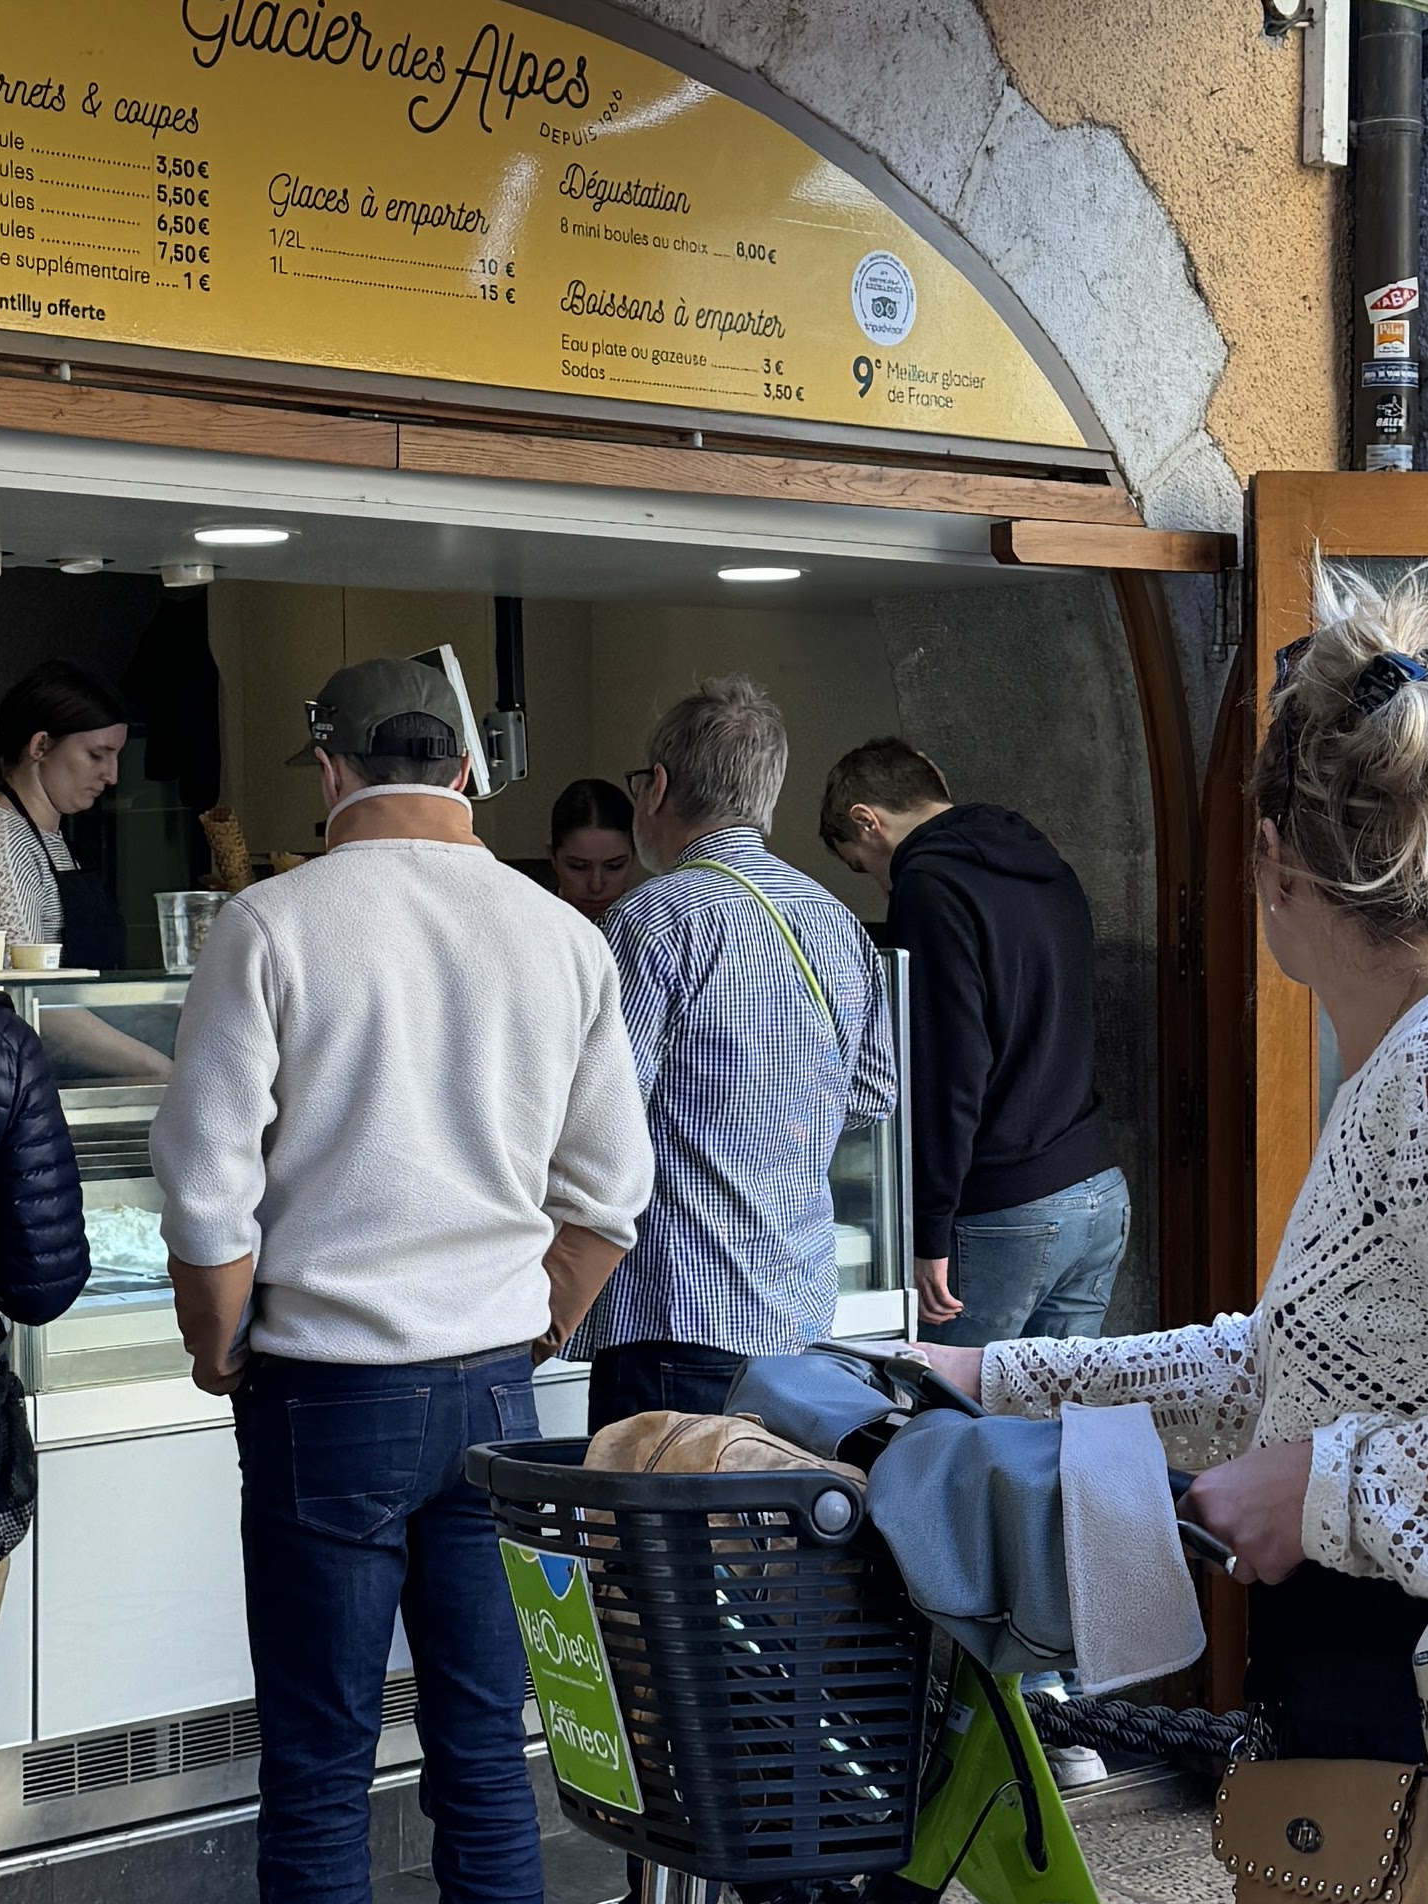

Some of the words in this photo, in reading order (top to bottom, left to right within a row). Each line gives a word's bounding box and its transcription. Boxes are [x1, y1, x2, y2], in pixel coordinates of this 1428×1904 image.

[389, 34, 445, 83] des
[409, 24, 590, 134] Alpes
[82, 83, 102, 117] &
[115, 98, 198, 139] coupes
[540, 123, 597, 146] DEPUIS
[269, 173, 349, 217] Glaces
[361, 186, 378, 218] à
[386, 199, 490, 235] emporter
[560, 163, 690, 213] Dégustation
[270, 228, 305, 249] 1/2L
[479, 259, 497, 275] 10
[506, 262, 515, 278] €
[561, 217, 568, 233] 8
[573, 224, 600, 238] mini
[605, 225, 648, 245] boules
[653, 237, 668, 248] au
[17, 250, 150, 284] supplémentaire
[184, 272, 191, 289] 1
[199, 274, 210, 291] €
[270, 256, 288, 274] 1L
[480, 285, 498, 300] 15
[506, 288, 515, 304] €
[48, 299, 105, 320] offerte
[561, 280, 664, 323] Boissons
[675, 298, 688, 326] à
[696, 308, 785, 340] emporter
[562, 334, 588, 352] Eau
[593, 343, 626, 357] plate
[632, 348, 647, 359] ou
[652, 350, 706, 366] gazeuse
[764, 359, 770, 373] 3
[776, 361, 783, 375] €
[888, 361, 938, 383] Meilleur
[942, 370, 985, 390] glacier
[562, 360, 605, 379] Sodas
[764, 383, 791, 399] 3,50
[796, 387, 804, 401] €
[888, 390, 904, 403] de
[909, 387, 953, 407] France
[548, 1699, 620, 1771] Annecy
